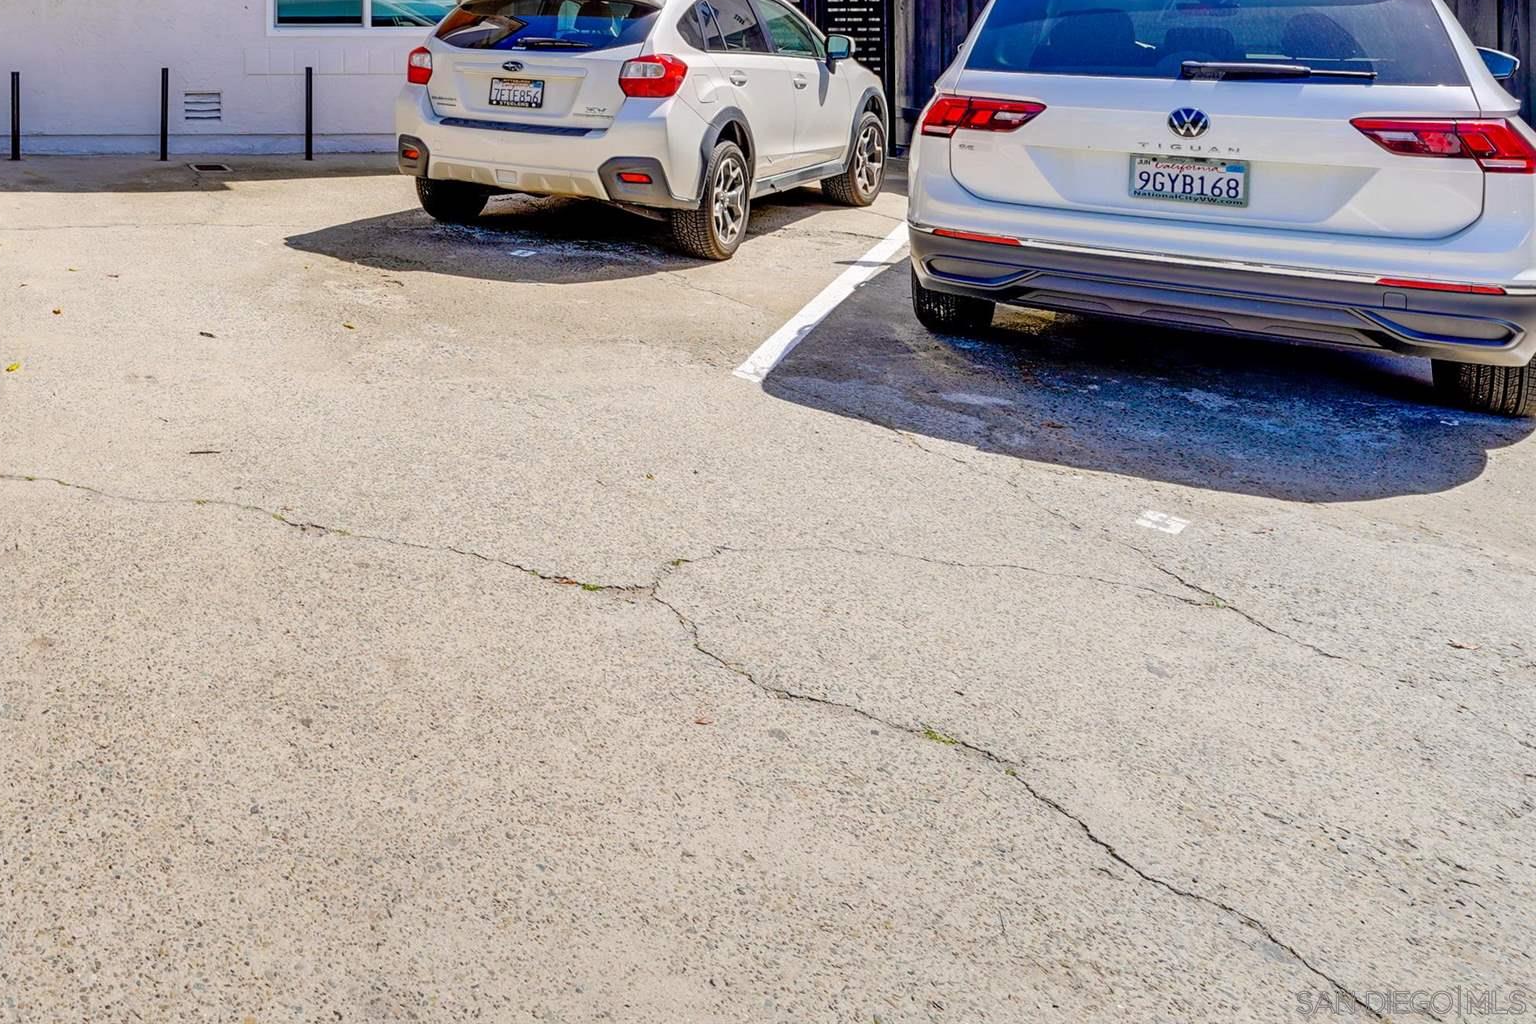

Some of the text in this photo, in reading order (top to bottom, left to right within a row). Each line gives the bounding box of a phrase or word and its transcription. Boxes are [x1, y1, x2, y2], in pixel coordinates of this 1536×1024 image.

[1137, 141, 1241, 153] TIGUAN
[1154, 161, 1226, 174] California
[1138, 170, 1240, 199] 9GYB168
[1132, 189, 1244, 206] NationalCityVW.com
